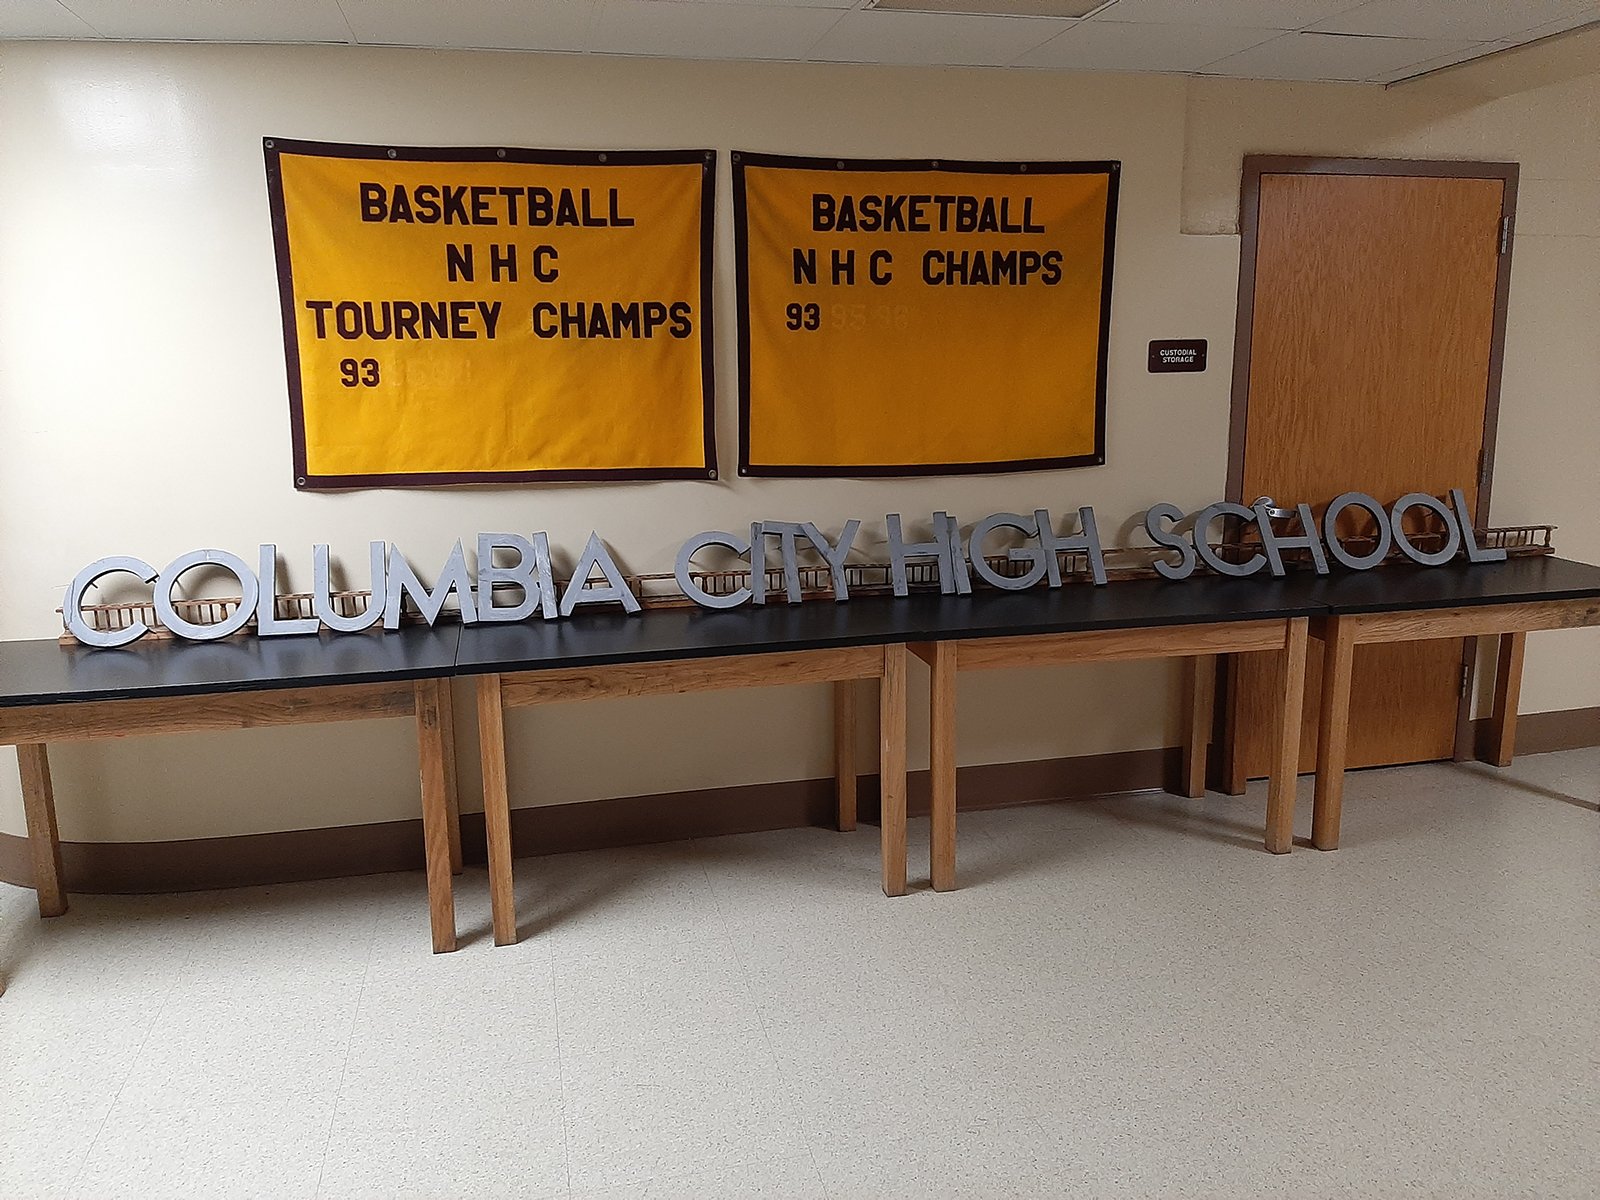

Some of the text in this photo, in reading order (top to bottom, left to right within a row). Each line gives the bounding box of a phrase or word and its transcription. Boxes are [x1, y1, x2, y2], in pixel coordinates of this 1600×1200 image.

[360, 182, 635, 228] BASKETBALL
[812, 193, 1046, 234] BASKETBALL
[922, 249, 1064, 287] CHAMPS
[305, 300, 692, 340] TOURNEY CHAMPS
[786, 302, 821, 331] 93
[1159, 348, 1197, 356] CUSTODIAL
[340, 358, 380, 387] 93
[63, 488, 1508, 649] COLUMBIA CITY HIGH SCHOOL
